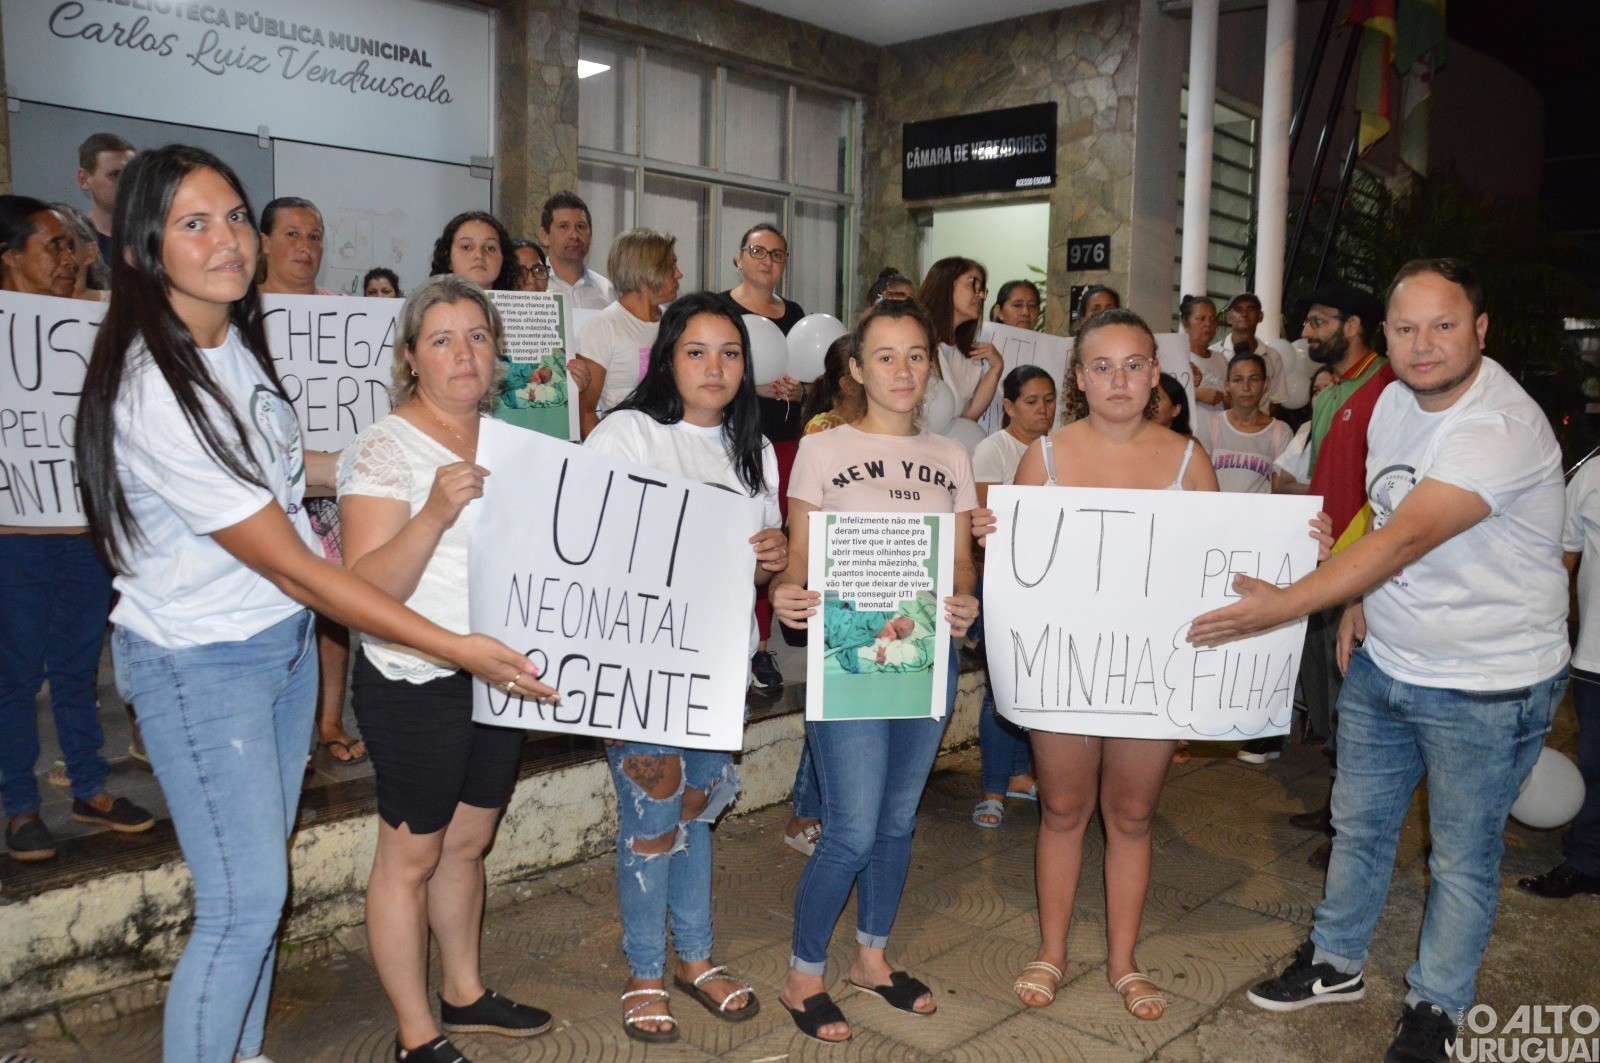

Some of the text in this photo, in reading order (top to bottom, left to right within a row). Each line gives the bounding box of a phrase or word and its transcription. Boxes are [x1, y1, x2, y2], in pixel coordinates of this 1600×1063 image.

[234, 9, 325, 47] PÚBLICA
[328, 30, 433, 67] MUNICIPAL
[48, 1, 454, 104] Carlos Luiz Vendruscolo
[907, 133, 1047, 169] CÂMARA DE VEREADORES
[1015, 178, 1032, 187] ACESSO
[1070, 243, 1104, 263] 976
[1, 408, 77, 448] PELO
[832, 460, 956, 494] NEW YORK
[889, 489, 920, 500] 1990
[552, 457, 689, 587] UTI
[835, 527, 860, 535] deram
[912, 529, 925, 537] pra
[832, 548, 851, 556] abrir
[912, 550, 926, 558] pra
[869, 539, 884, 547] que
[918, 538, 928, 546] de
[1011, 499, 1155, 598] UTI
[832, 570, 863, 578] quantos
[866, 569, 900, 577] inocente
[879, 559, 919, 568] mãezinha,
[842, 591, 855, 599] pra
[858, 591, 897, 599] conseguir
[856, 581, 870, 589] que
[899, 580, 908, 588] de
[505, 573, 699, 653] NEONATAL
[1010, 623, 1292, 712] MINHA FILHA
[487, 648, 711, 737] URGENTE
